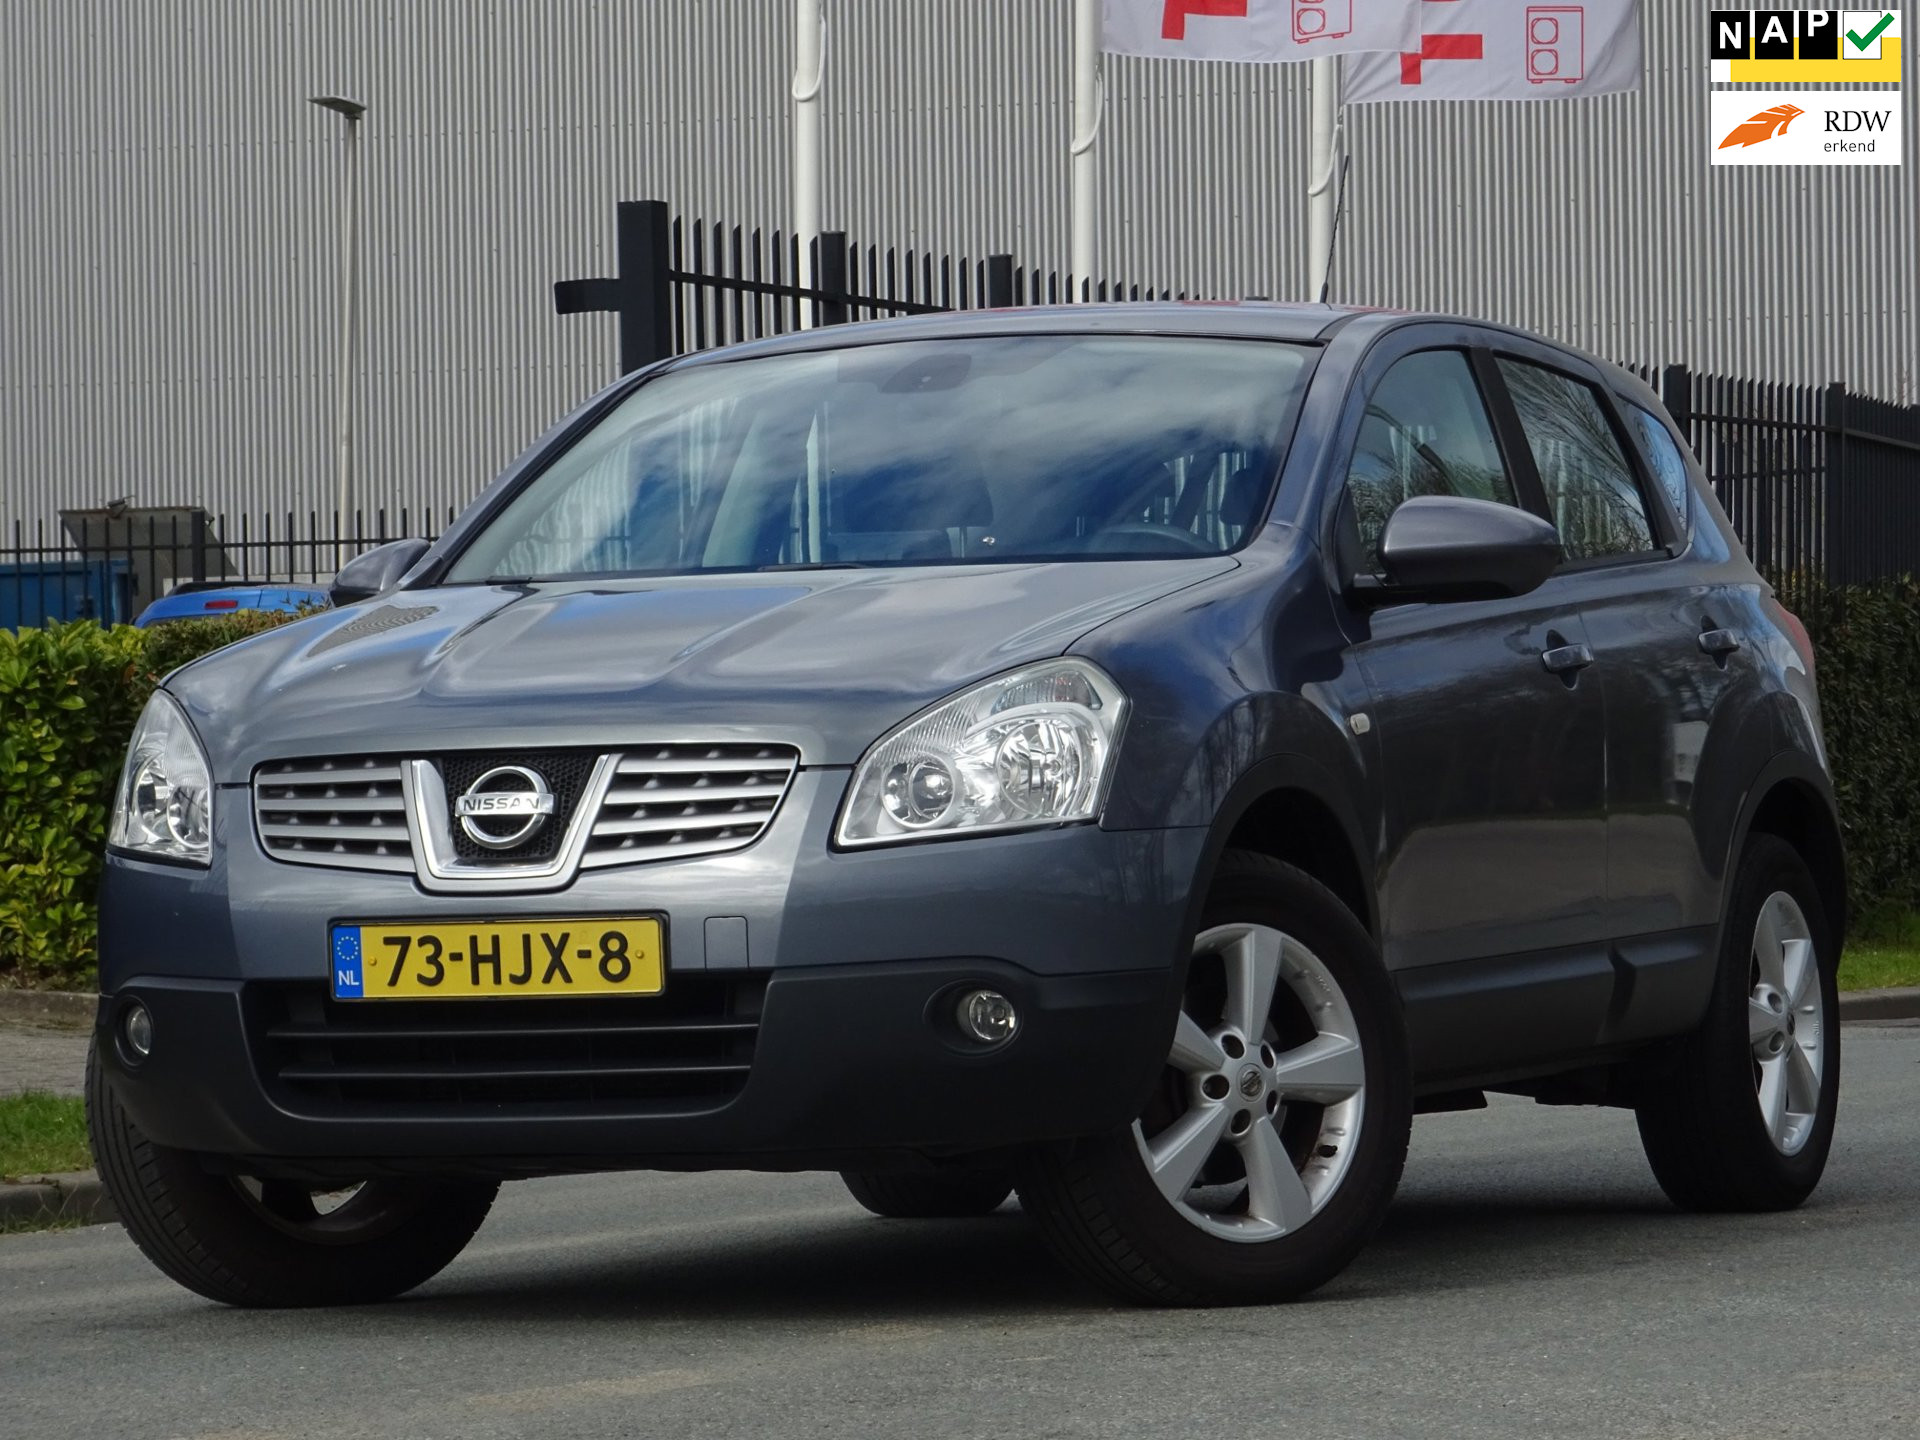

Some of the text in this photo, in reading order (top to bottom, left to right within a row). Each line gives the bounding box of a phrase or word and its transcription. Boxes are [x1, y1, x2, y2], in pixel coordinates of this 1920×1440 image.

[463, 798, 540, 811] NISSAN
[382, 931, 631, 987] 73-HJX-8
[338, 970, 359, 986] NL
